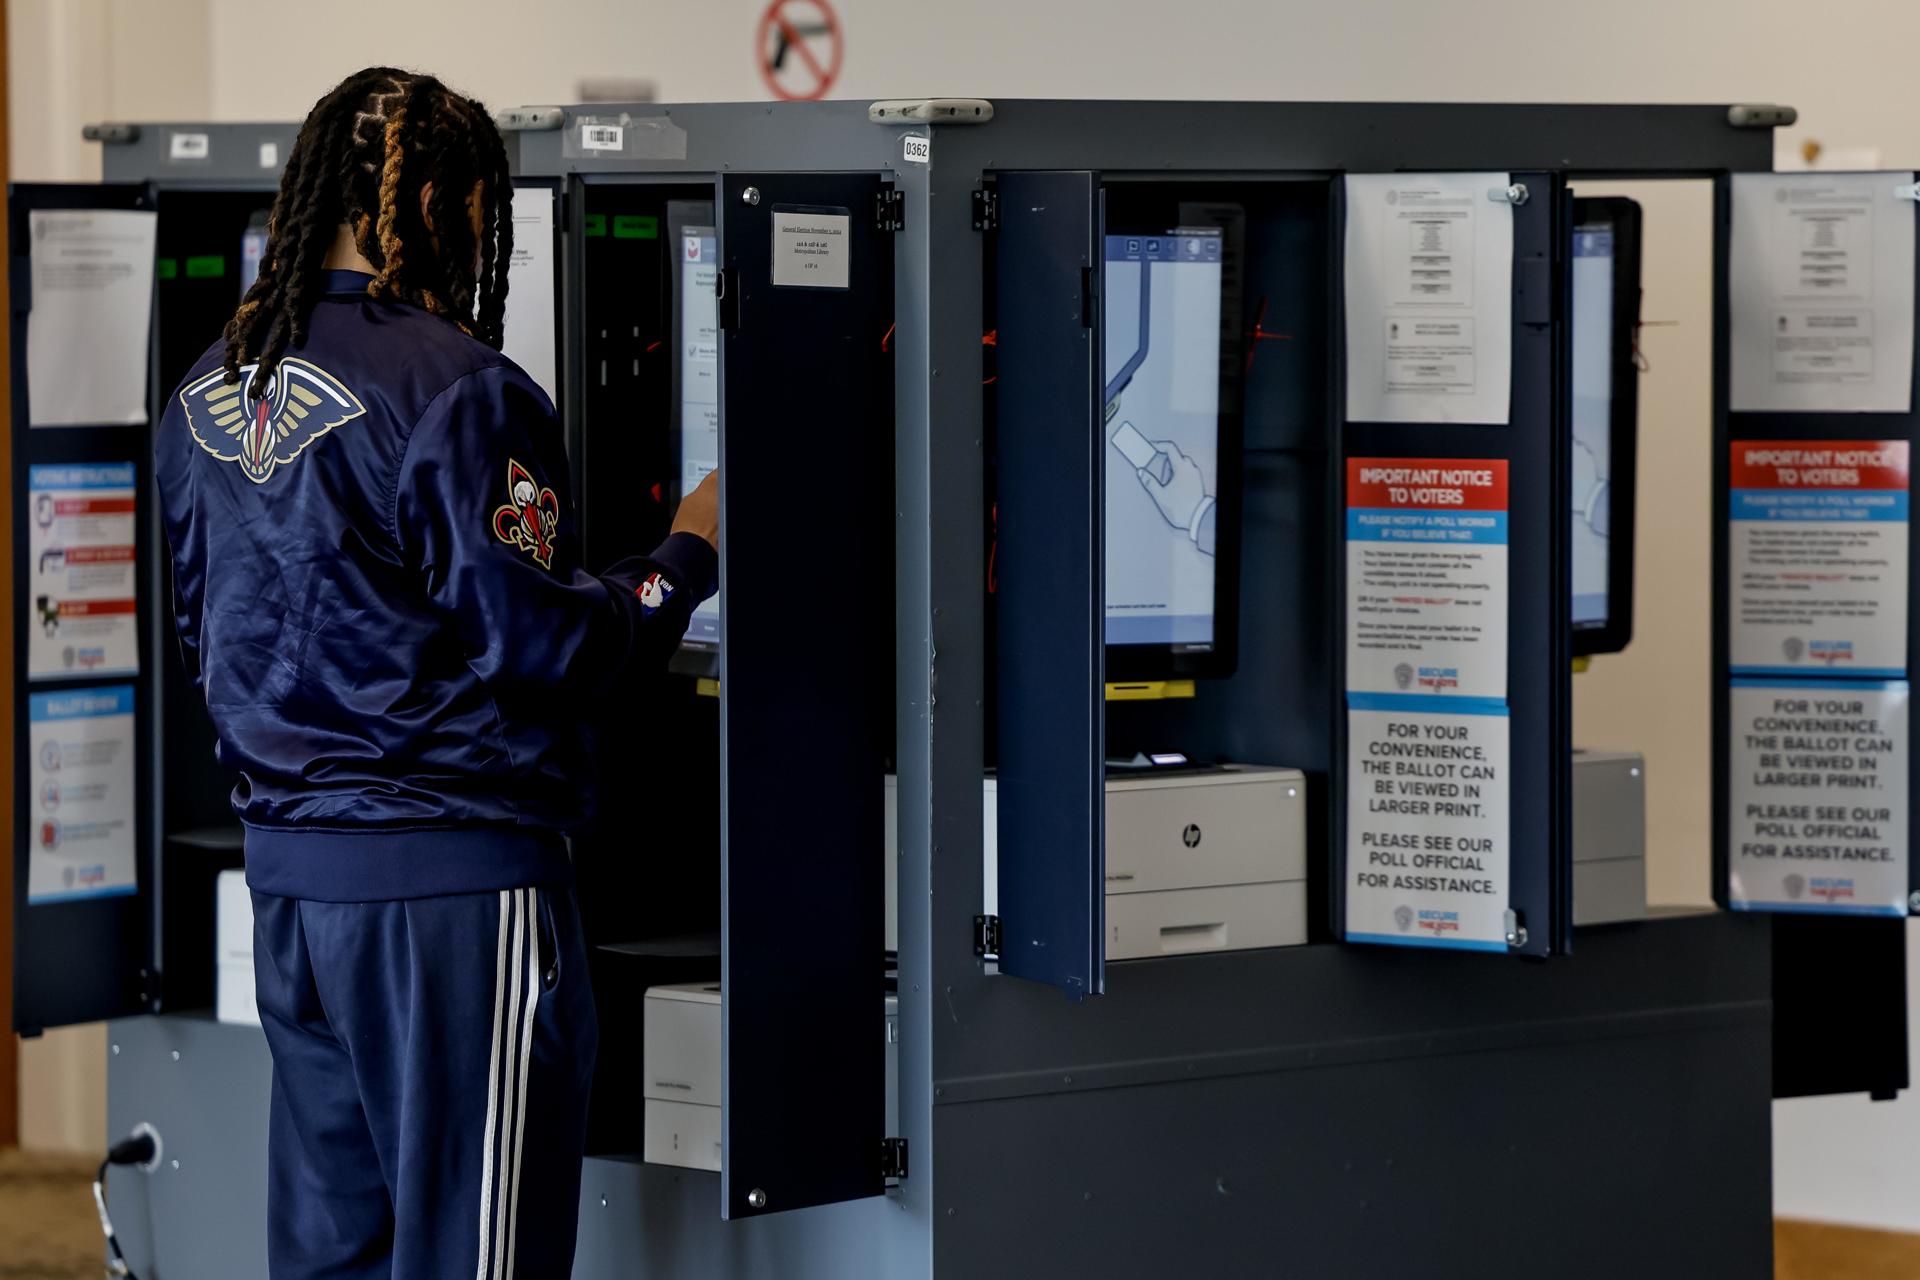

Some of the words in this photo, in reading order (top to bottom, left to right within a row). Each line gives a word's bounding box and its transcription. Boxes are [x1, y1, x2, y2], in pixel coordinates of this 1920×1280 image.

[906, 142, 928, 157] 0362
[1745, 450, 1833, 466] IMPORTANT
[1360, 468, 1438, 484] IMPORTANT
[1441, 470, 1492, 486] NOTICE
[1776, 468, 1798, 484] TO
[1801, 469, 1860, 485] VOTERS
[1389, 488, 1408, 503] TO
[1410, 488, 1464, 504] VOTERS
[660, 579, 674, 592] NBA
[1774, 699, 1808, 714] FOR
[1813, 701, 1863, 715] YOUR
[1388, 723, 1419, 738] FOR
[1424, 725, 1468, 741] YOUR
[1369, 742, 1487, 762] CONVENIENCE,
[1745, 735, 1777, 749] THE
[1783, 737, 1849, 751] BALLOT
[1855, 738, 1892, 752] CAN
[1362, 760, 1391, 775] THE
[1396, 762, 1455, 778] BALLOT
[1460, 765, 1495, 780] CAN
[1759, 754, 1781, 768] BE
[1786, 755, 1854, 769] VIEWED
[1858, 756, 1877, 770] IN
[1375, 780, 1393, 794] BE
[1399, 781, 1459, 797] VIEWED
[1464, 784, 1480, 798] IN
[1754, 772, 1821, 786] LARGER
[1826, 774, 1883, 790] PRINT.
[1369, 800, 1430, 816] LARGER
[1435, 802, 1486, 818] PRINT.
[1746, 804, 1811, 820] PLEASE
[1816, 806, 1846, 821] SEE
[1851, 807, 1890, 822] OUR
[1183, 824, 1201, 848] hp
[1755, 823, 1797, 838] POLL
[1803, 824, 1881, 840] OFFICIAL
[1362, 832, 1419, 850] PLEASE
[1424, 836, 1453, 851] SEE
[1457, 837, 1493, 853] OUR
[1369, 852, 1407, 867] POLL
[1412, 854, 1484, 871] OFFICIAL
[1741, 843, 1776, 858] FOR
[1782, 844, 1895, 862] ASSISTANCE.
[1358, 873, 1388, 888] FOR
[1393, 875, 1497, 895] ASSISTANCE.
